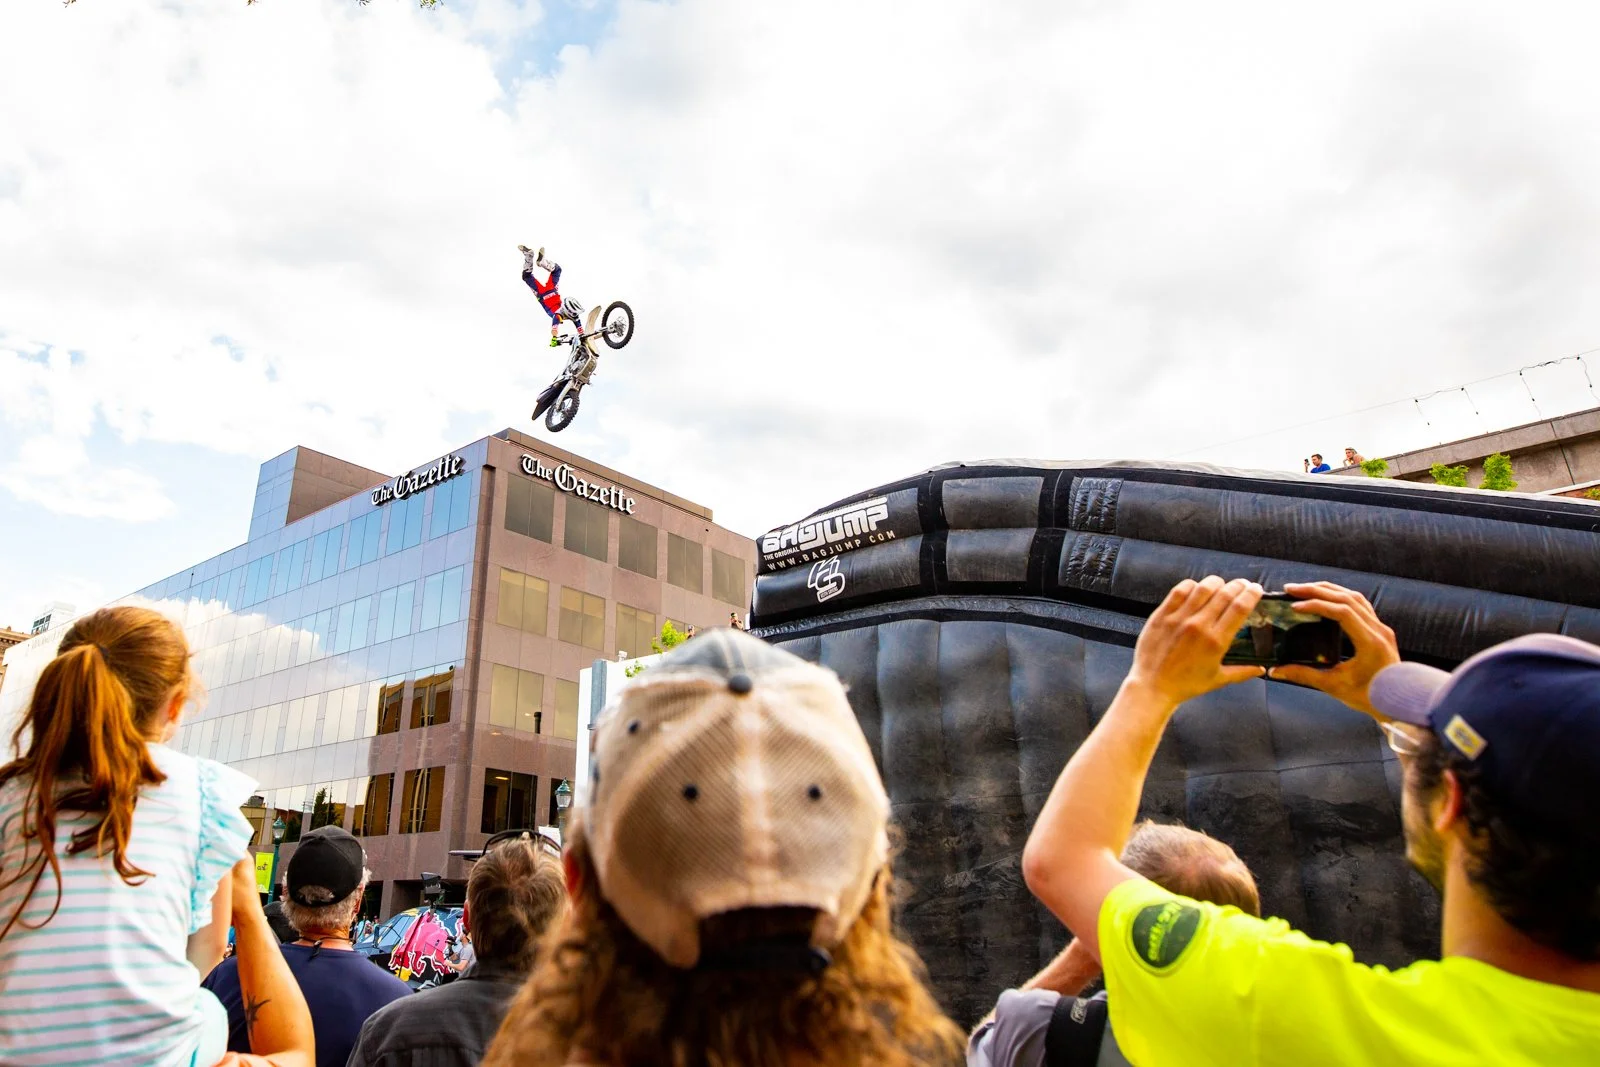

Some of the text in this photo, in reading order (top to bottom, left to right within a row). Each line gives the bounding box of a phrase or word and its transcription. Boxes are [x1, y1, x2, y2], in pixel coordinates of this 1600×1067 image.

[371, 454, 463, 506] The Gazette
[520, 452, 636, 515] The Gazette
[762, 497, 888, 554] BAGJUMP
[763, 546, 800, 561] THE ORIGINAL
